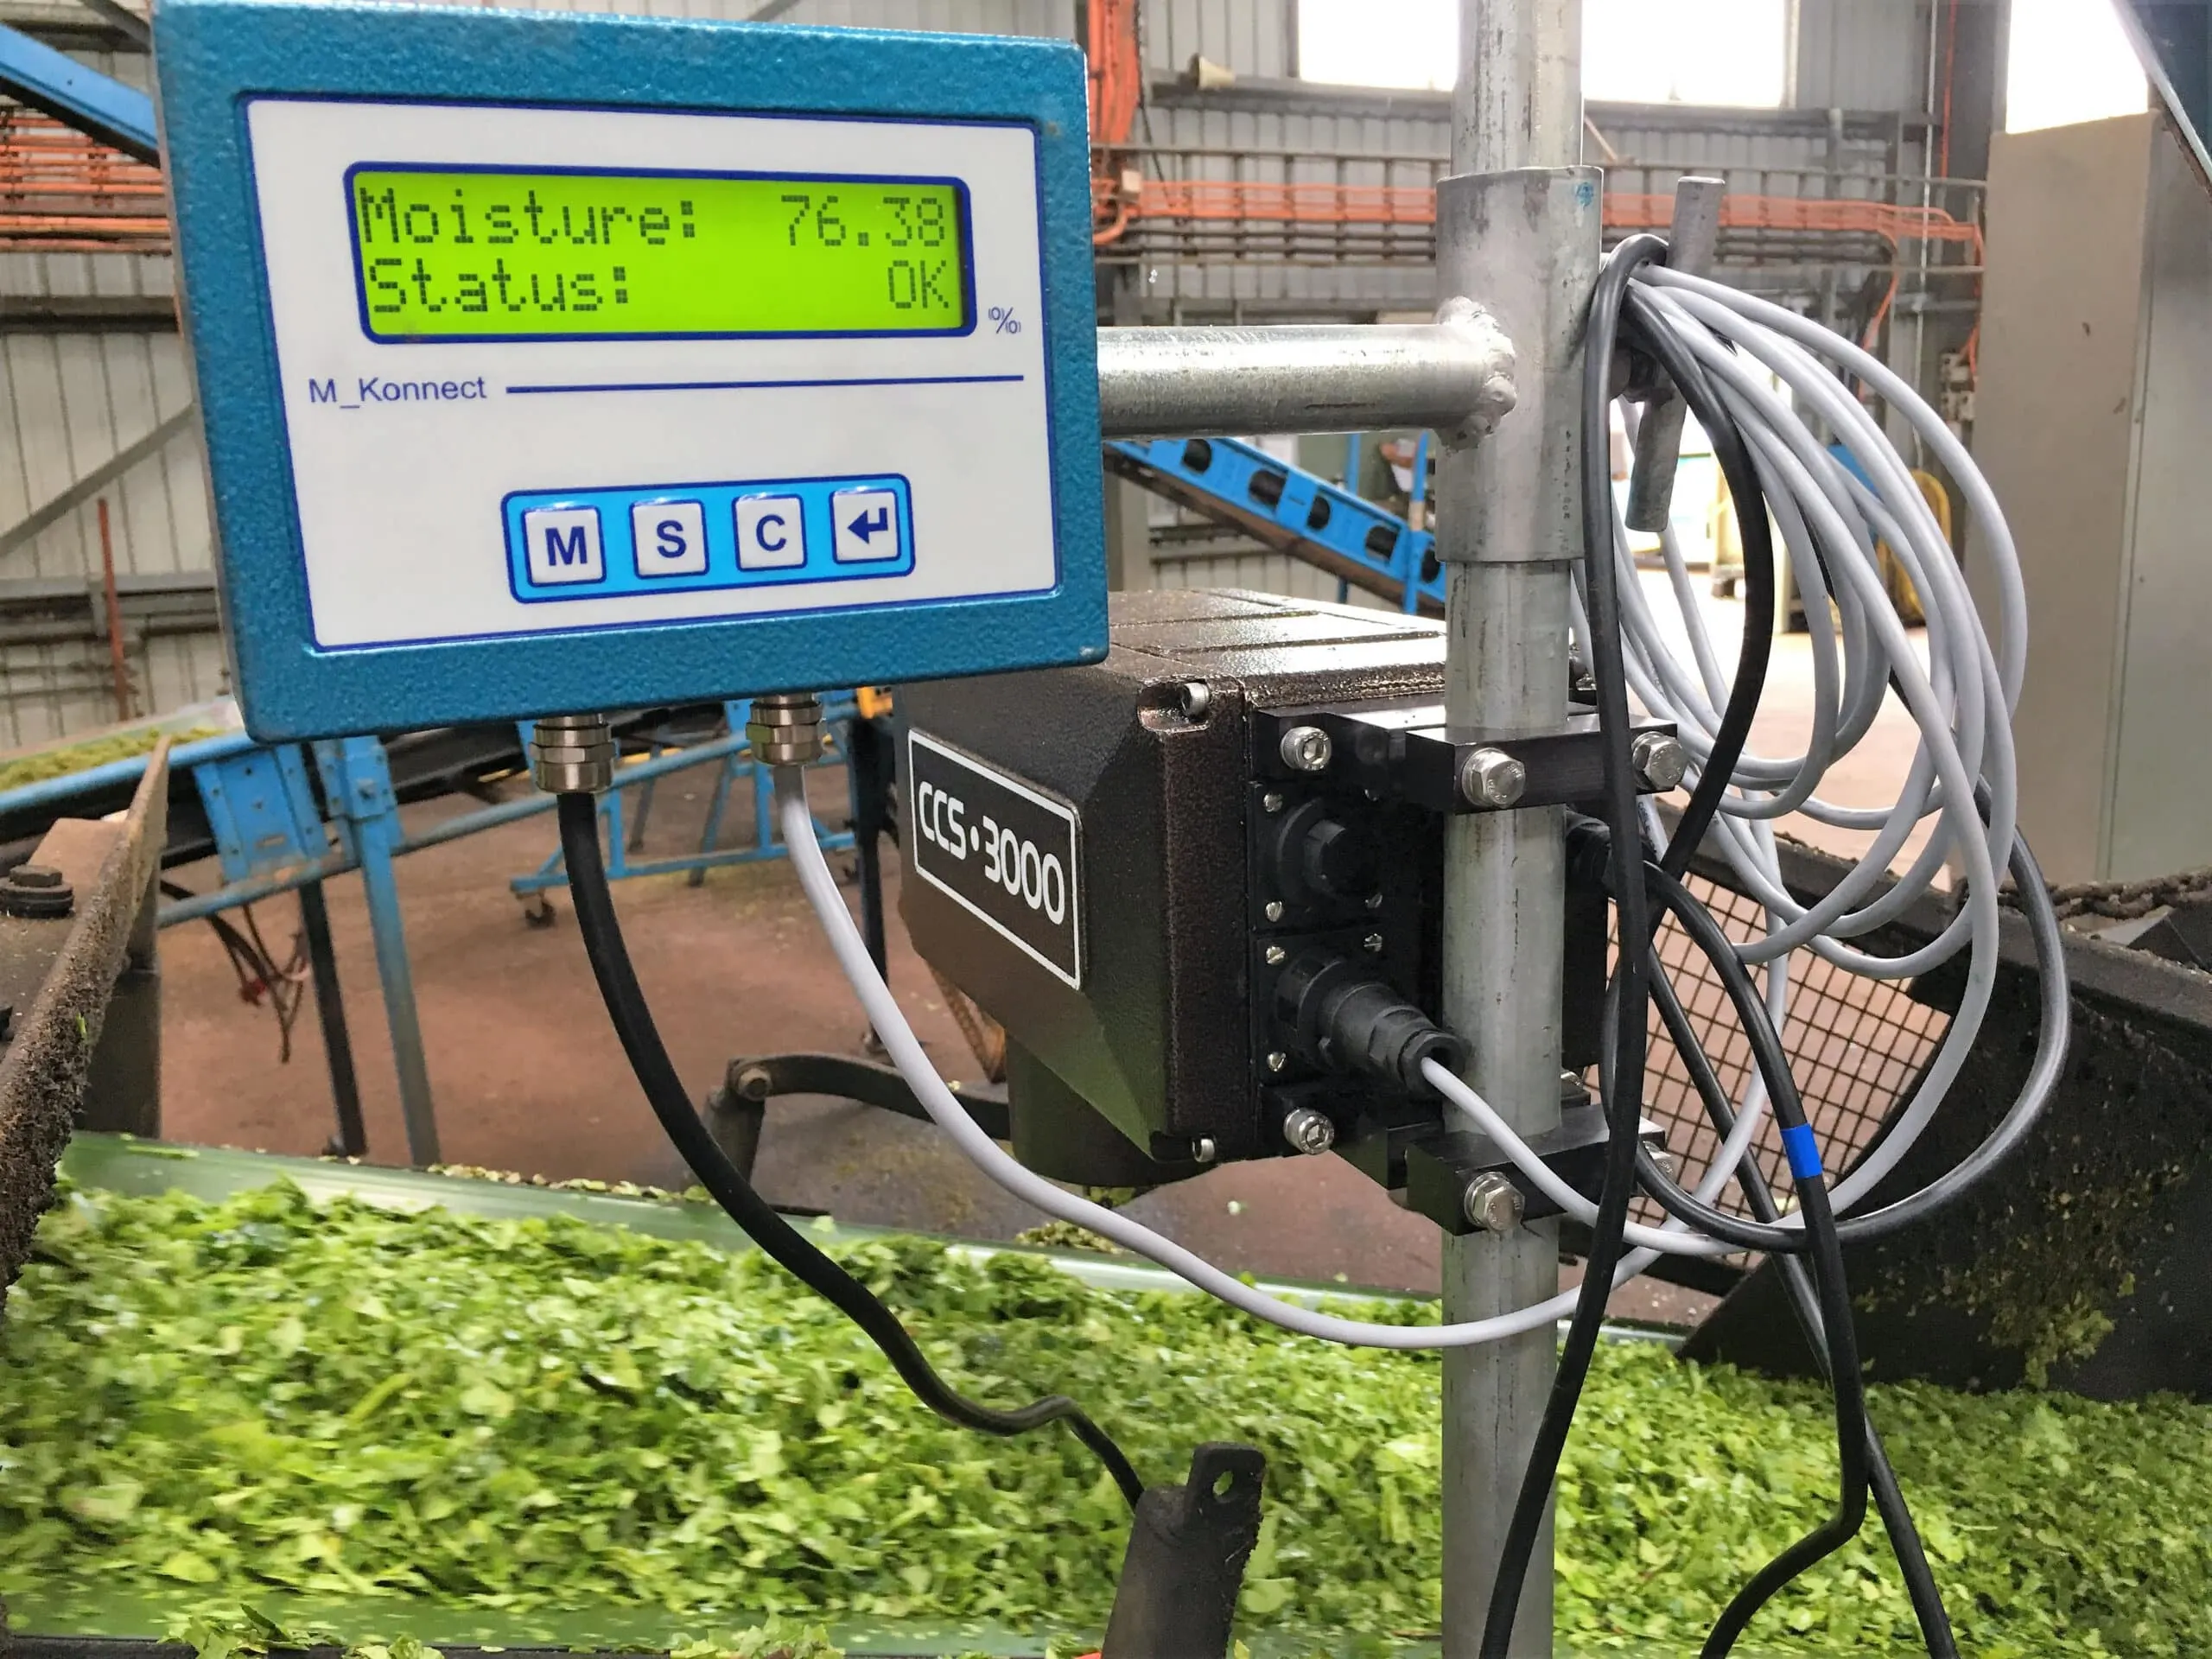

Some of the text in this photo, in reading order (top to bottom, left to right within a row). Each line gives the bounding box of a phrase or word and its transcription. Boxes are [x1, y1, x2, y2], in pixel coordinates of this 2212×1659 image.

[359, 187, 945, 247] Moisture: 76.38
[368, 257, 950, 313] Status: OK
[308, 376, 488, 410] M_Konnect
[544, 513, 787, 567] M S C
